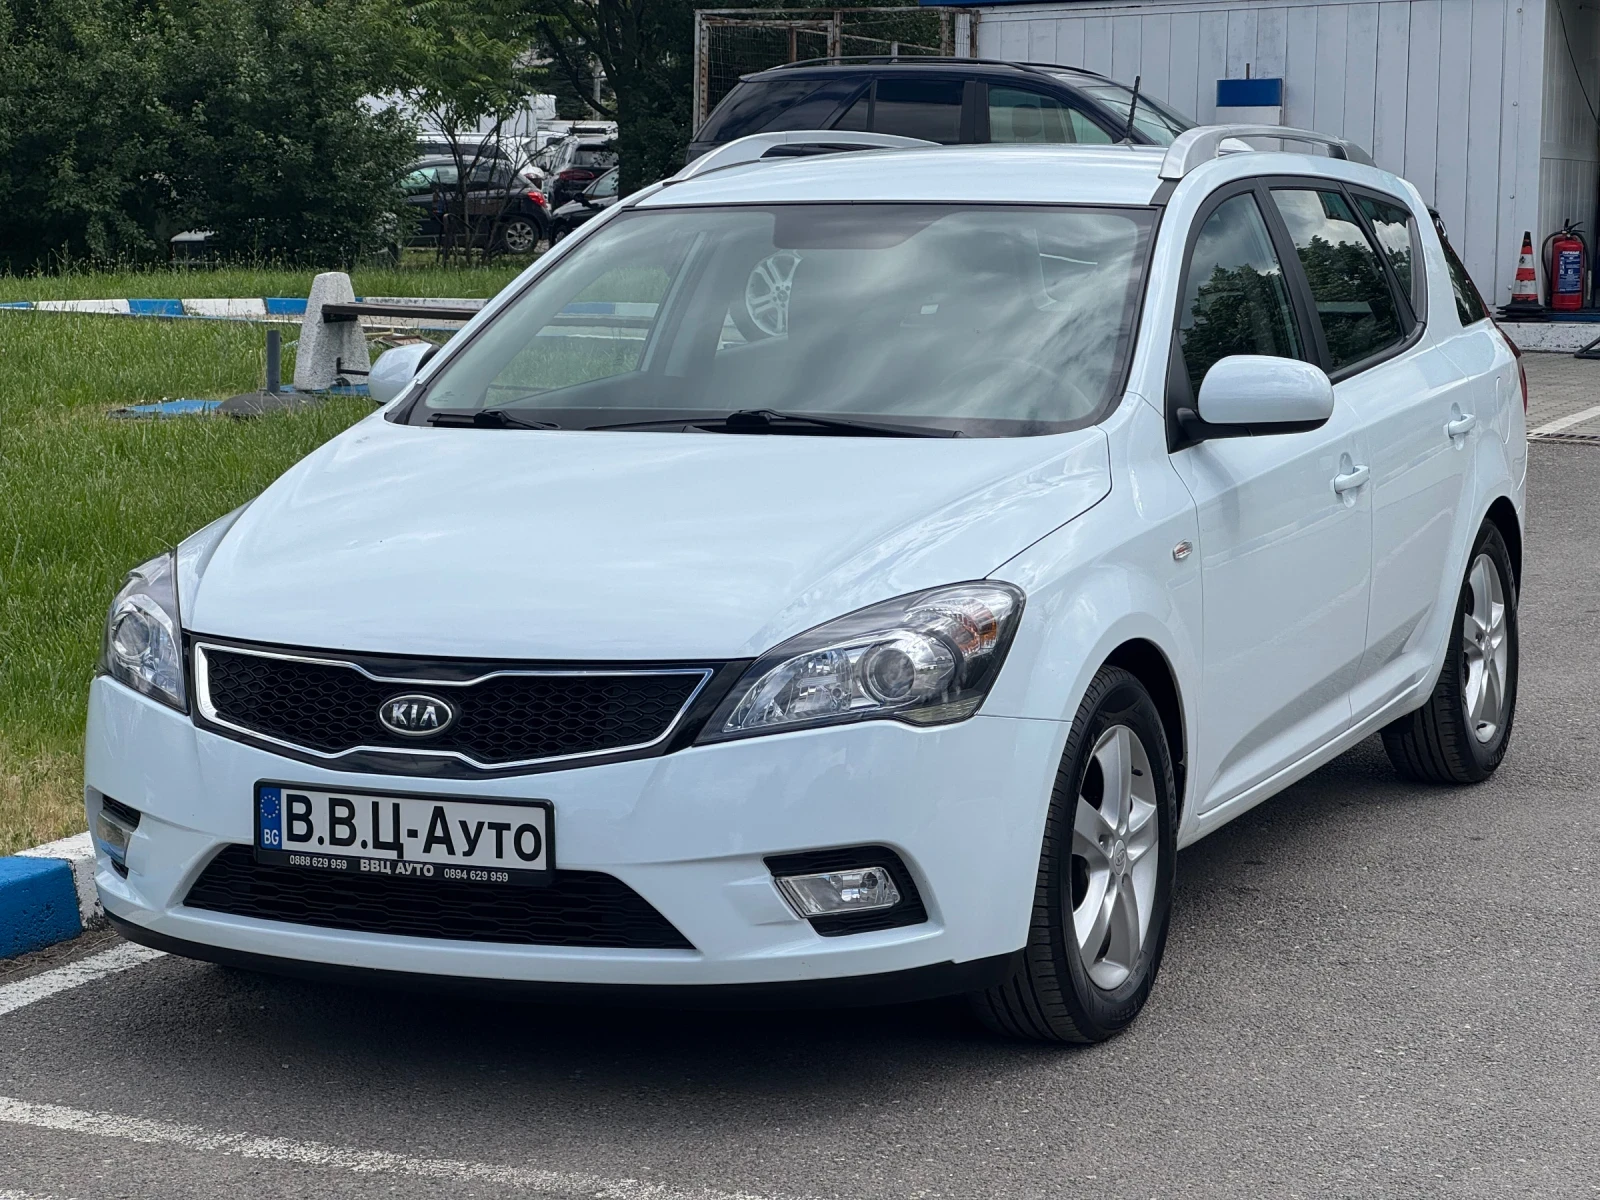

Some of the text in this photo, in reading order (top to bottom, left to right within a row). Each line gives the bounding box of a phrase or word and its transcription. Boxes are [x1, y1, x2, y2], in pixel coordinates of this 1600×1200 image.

[391, 703, 438, 727] KIA
[264, 829, 279, 845] BG
[286, 793, 542, 862] В.В.Ц-Ауто
[289, 854, 509, 882] 0888 629 959 ВВЦ АУТО 0894 629 959
